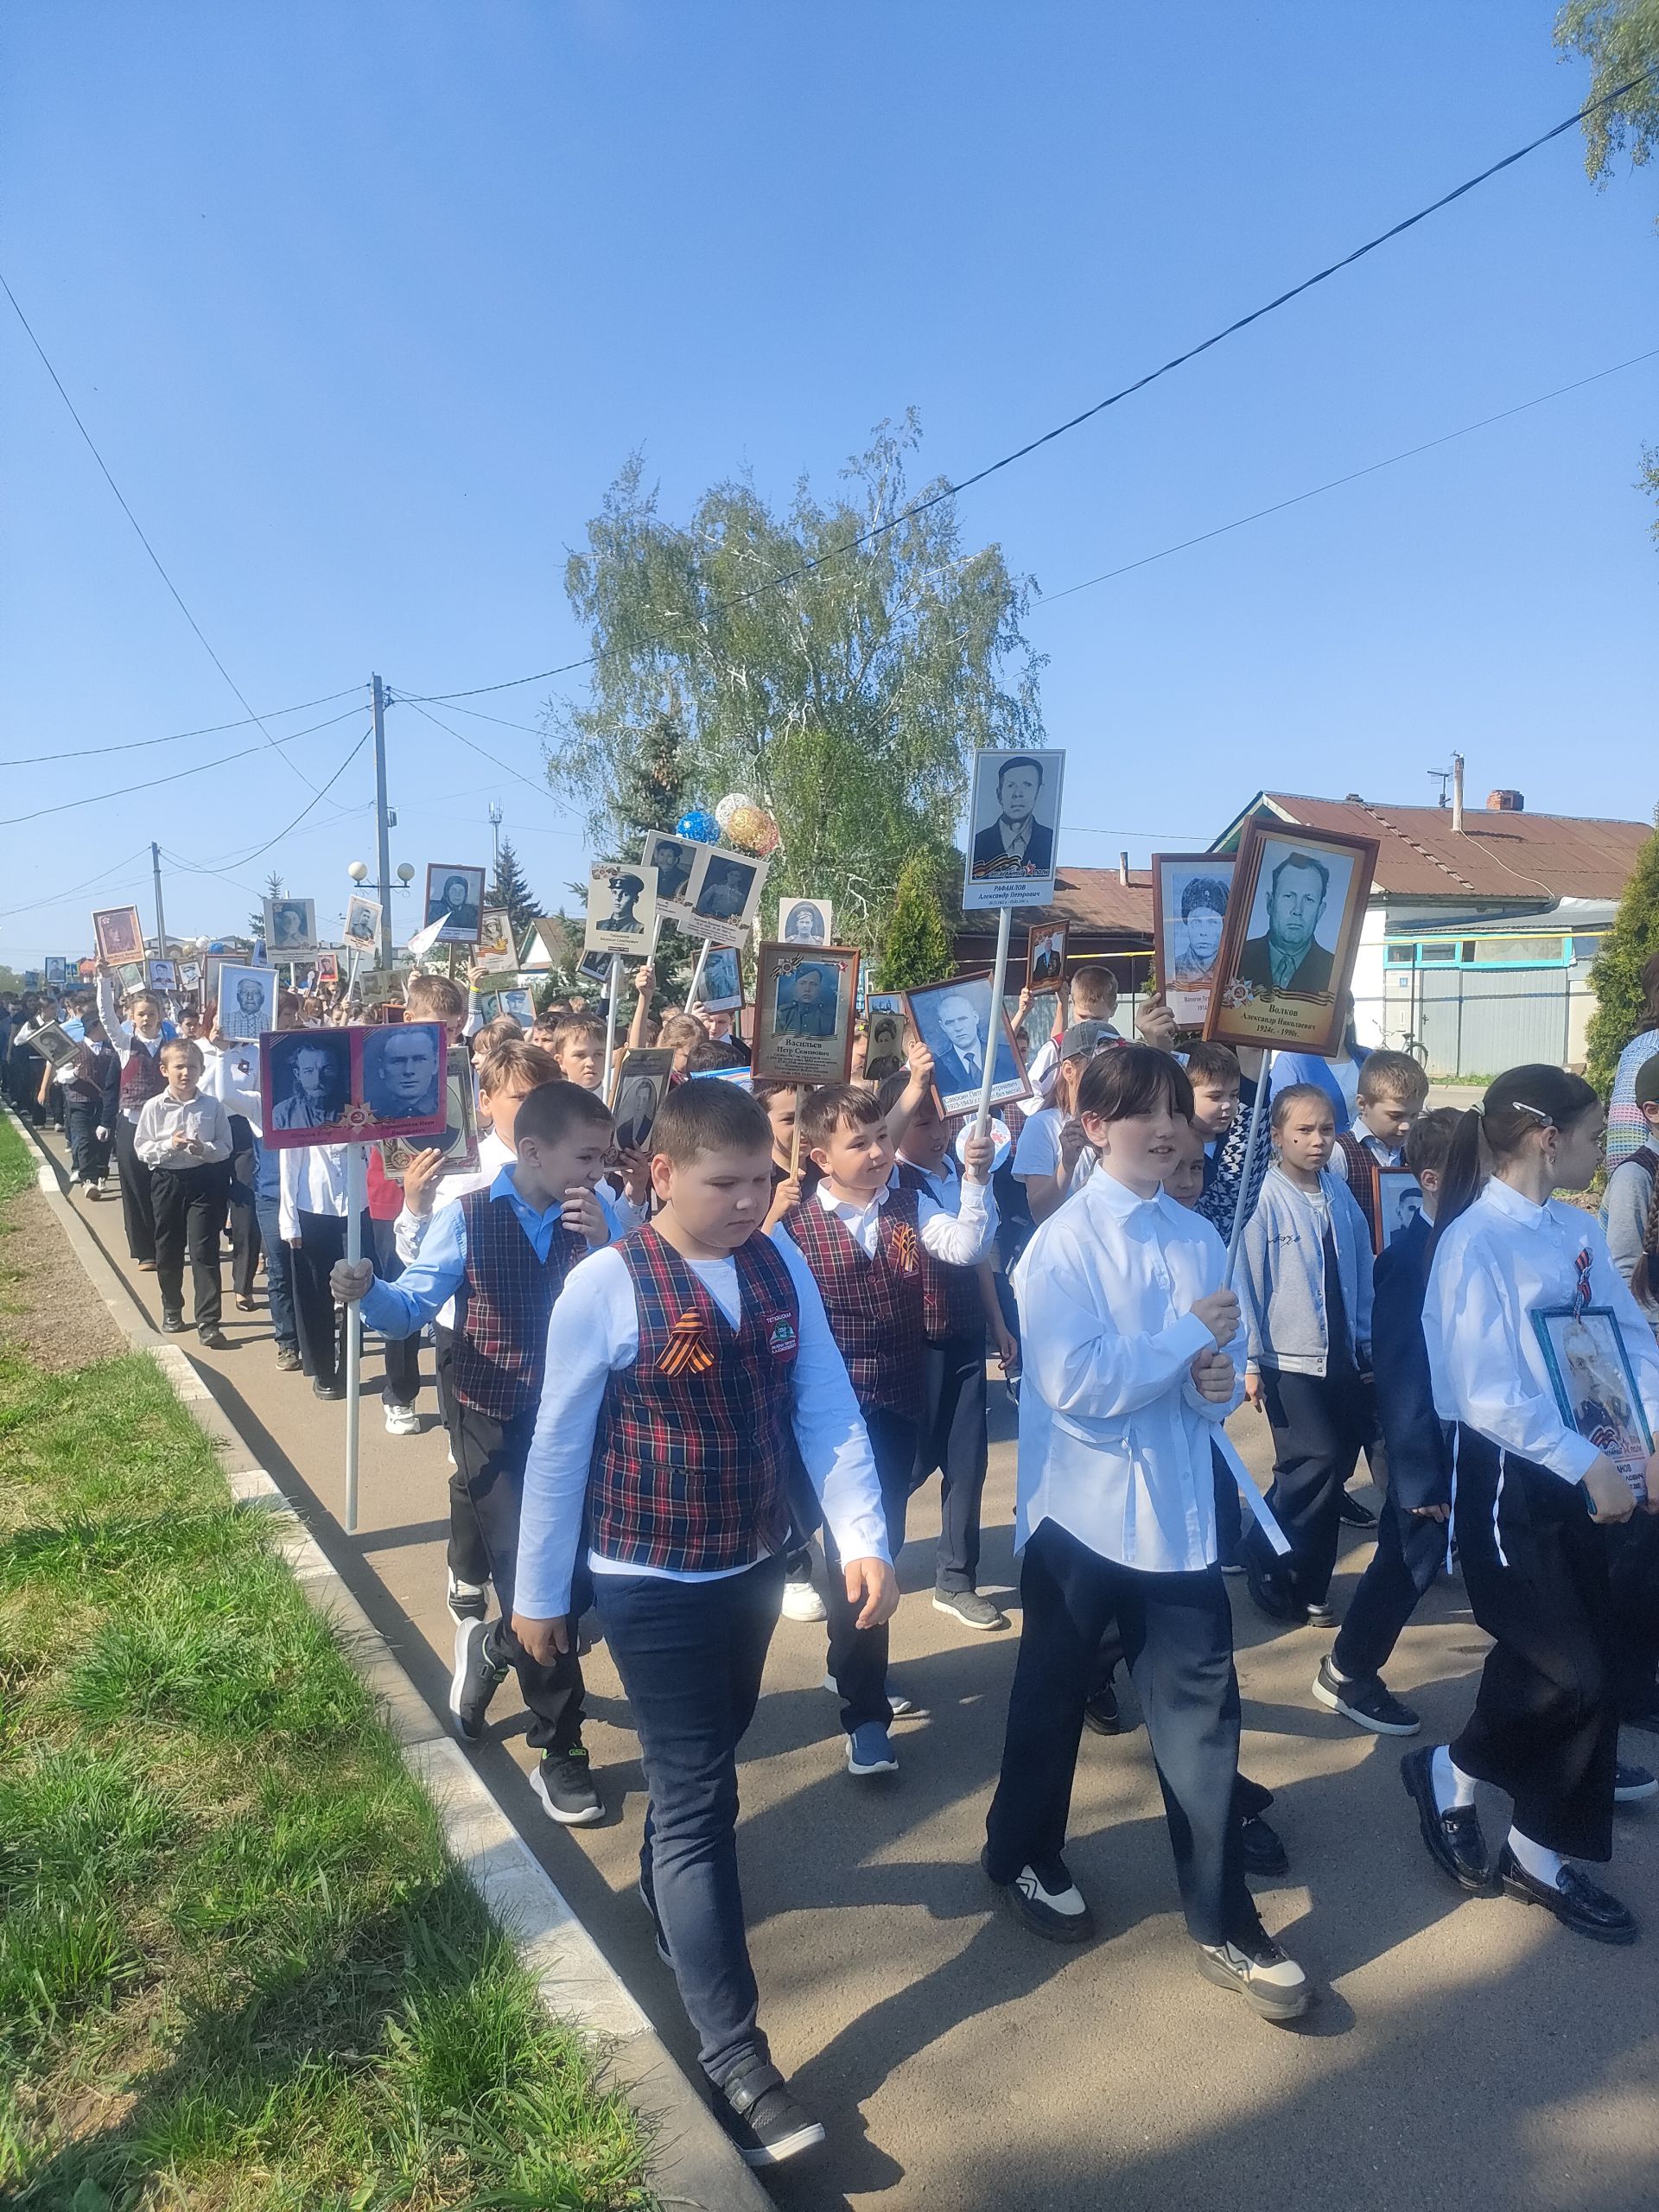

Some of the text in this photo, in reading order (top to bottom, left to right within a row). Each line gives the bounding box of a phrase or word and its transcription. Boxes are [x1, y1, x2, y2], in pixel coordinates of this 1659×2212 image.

[1268, 1004, 1299, 1017] Волков
[1241, 1012, 1316, 1031] Александр Николаевич
[1256, 1024, 1275, 1034] 1924г.
[1281, 1027, 1300, 1038] 1990г.
[785, 1039, 822, 1049] Васильев
[777, 1046, 830, 1057] Петр Семенович
[944, 1093, 969, 1103] Савосин
[992, 1082, 1018, 1092] итриевич
